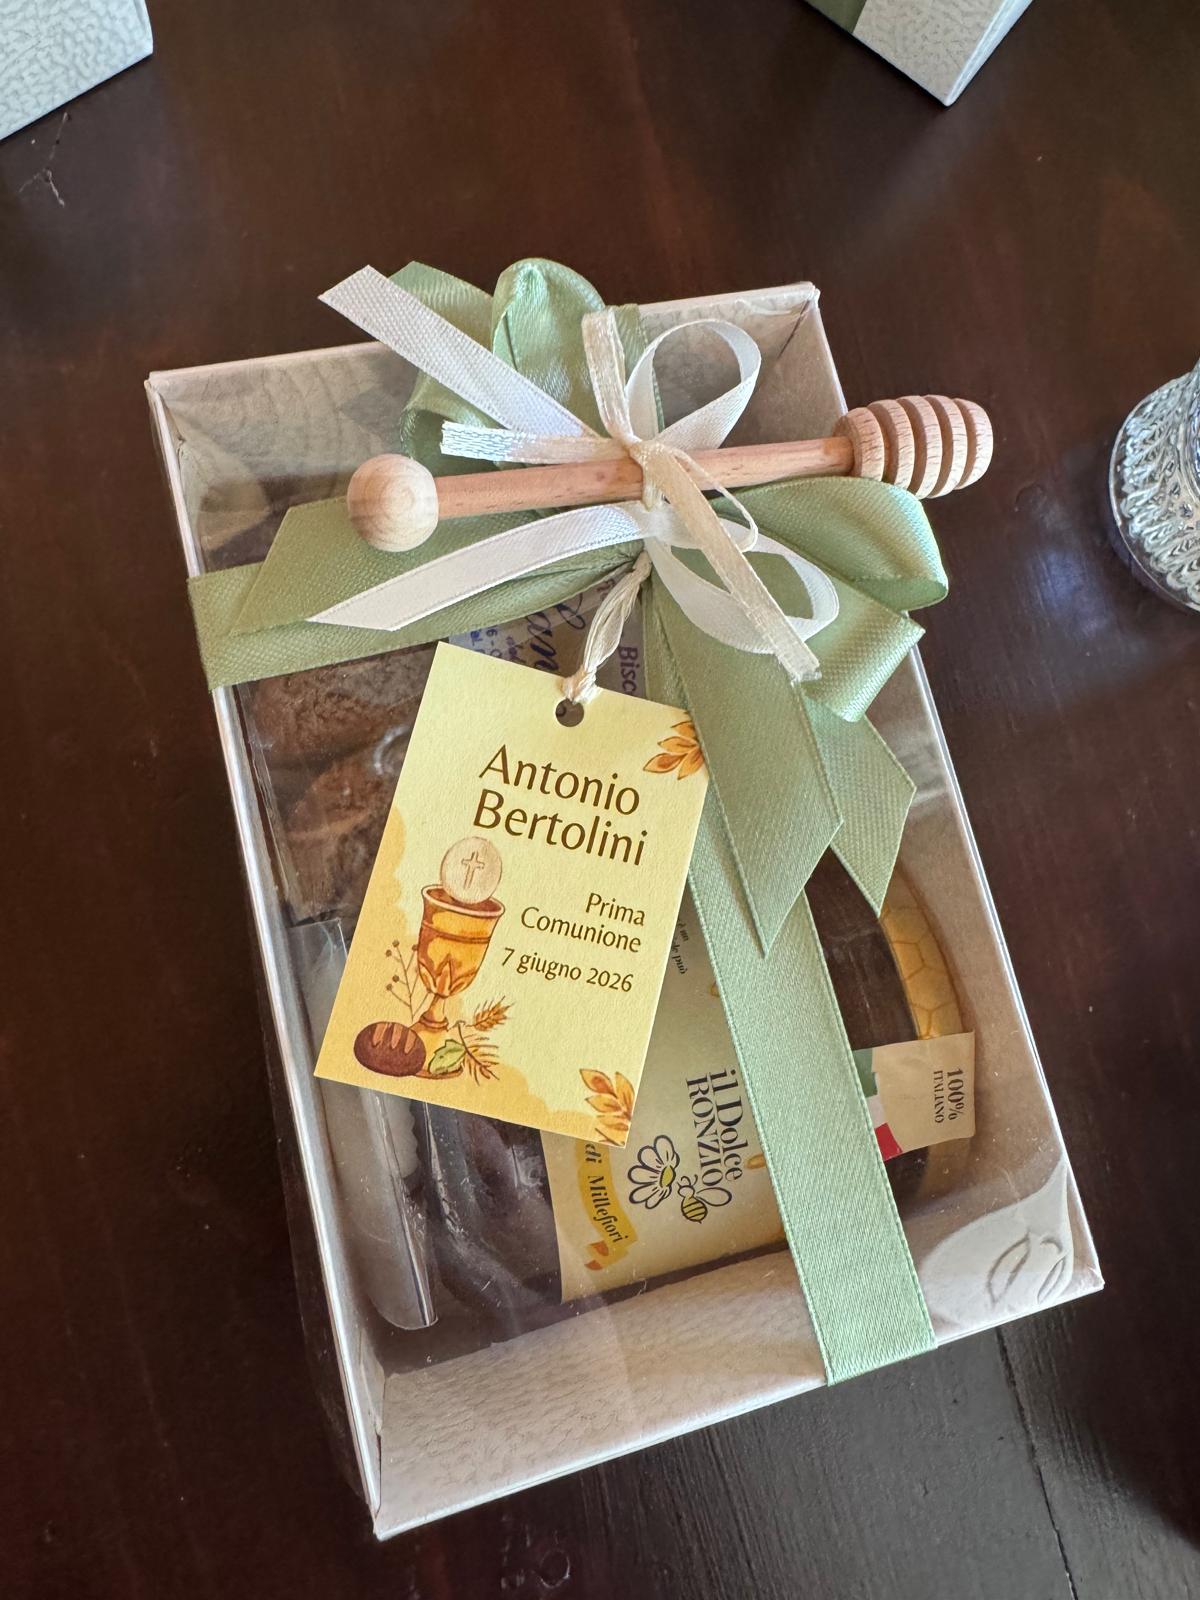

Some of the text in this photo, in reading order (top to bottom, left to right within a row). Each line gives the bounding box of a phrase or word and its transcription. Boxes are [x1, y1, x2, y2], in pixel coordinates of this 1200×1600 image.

[618, 646, 640, 693] Bisc
[478, 743, 641, 815] Antonio
[473, 788, 649, 866] Bertolini
[520, 906, 642, 953] Comunione
[585, 892, 646, 927] Prima
[501, 947, 634, 993] 7 giugno 2026
[933, 1070, 945, 1124] ITALIANO
[947, 1068, 966, 1121] 100%
[686, 1075, 724, 1187] RONZIO
[709, 1068, 748, 1181] il Dolce
[584, 1143, 630, 1244] di Millefiori
